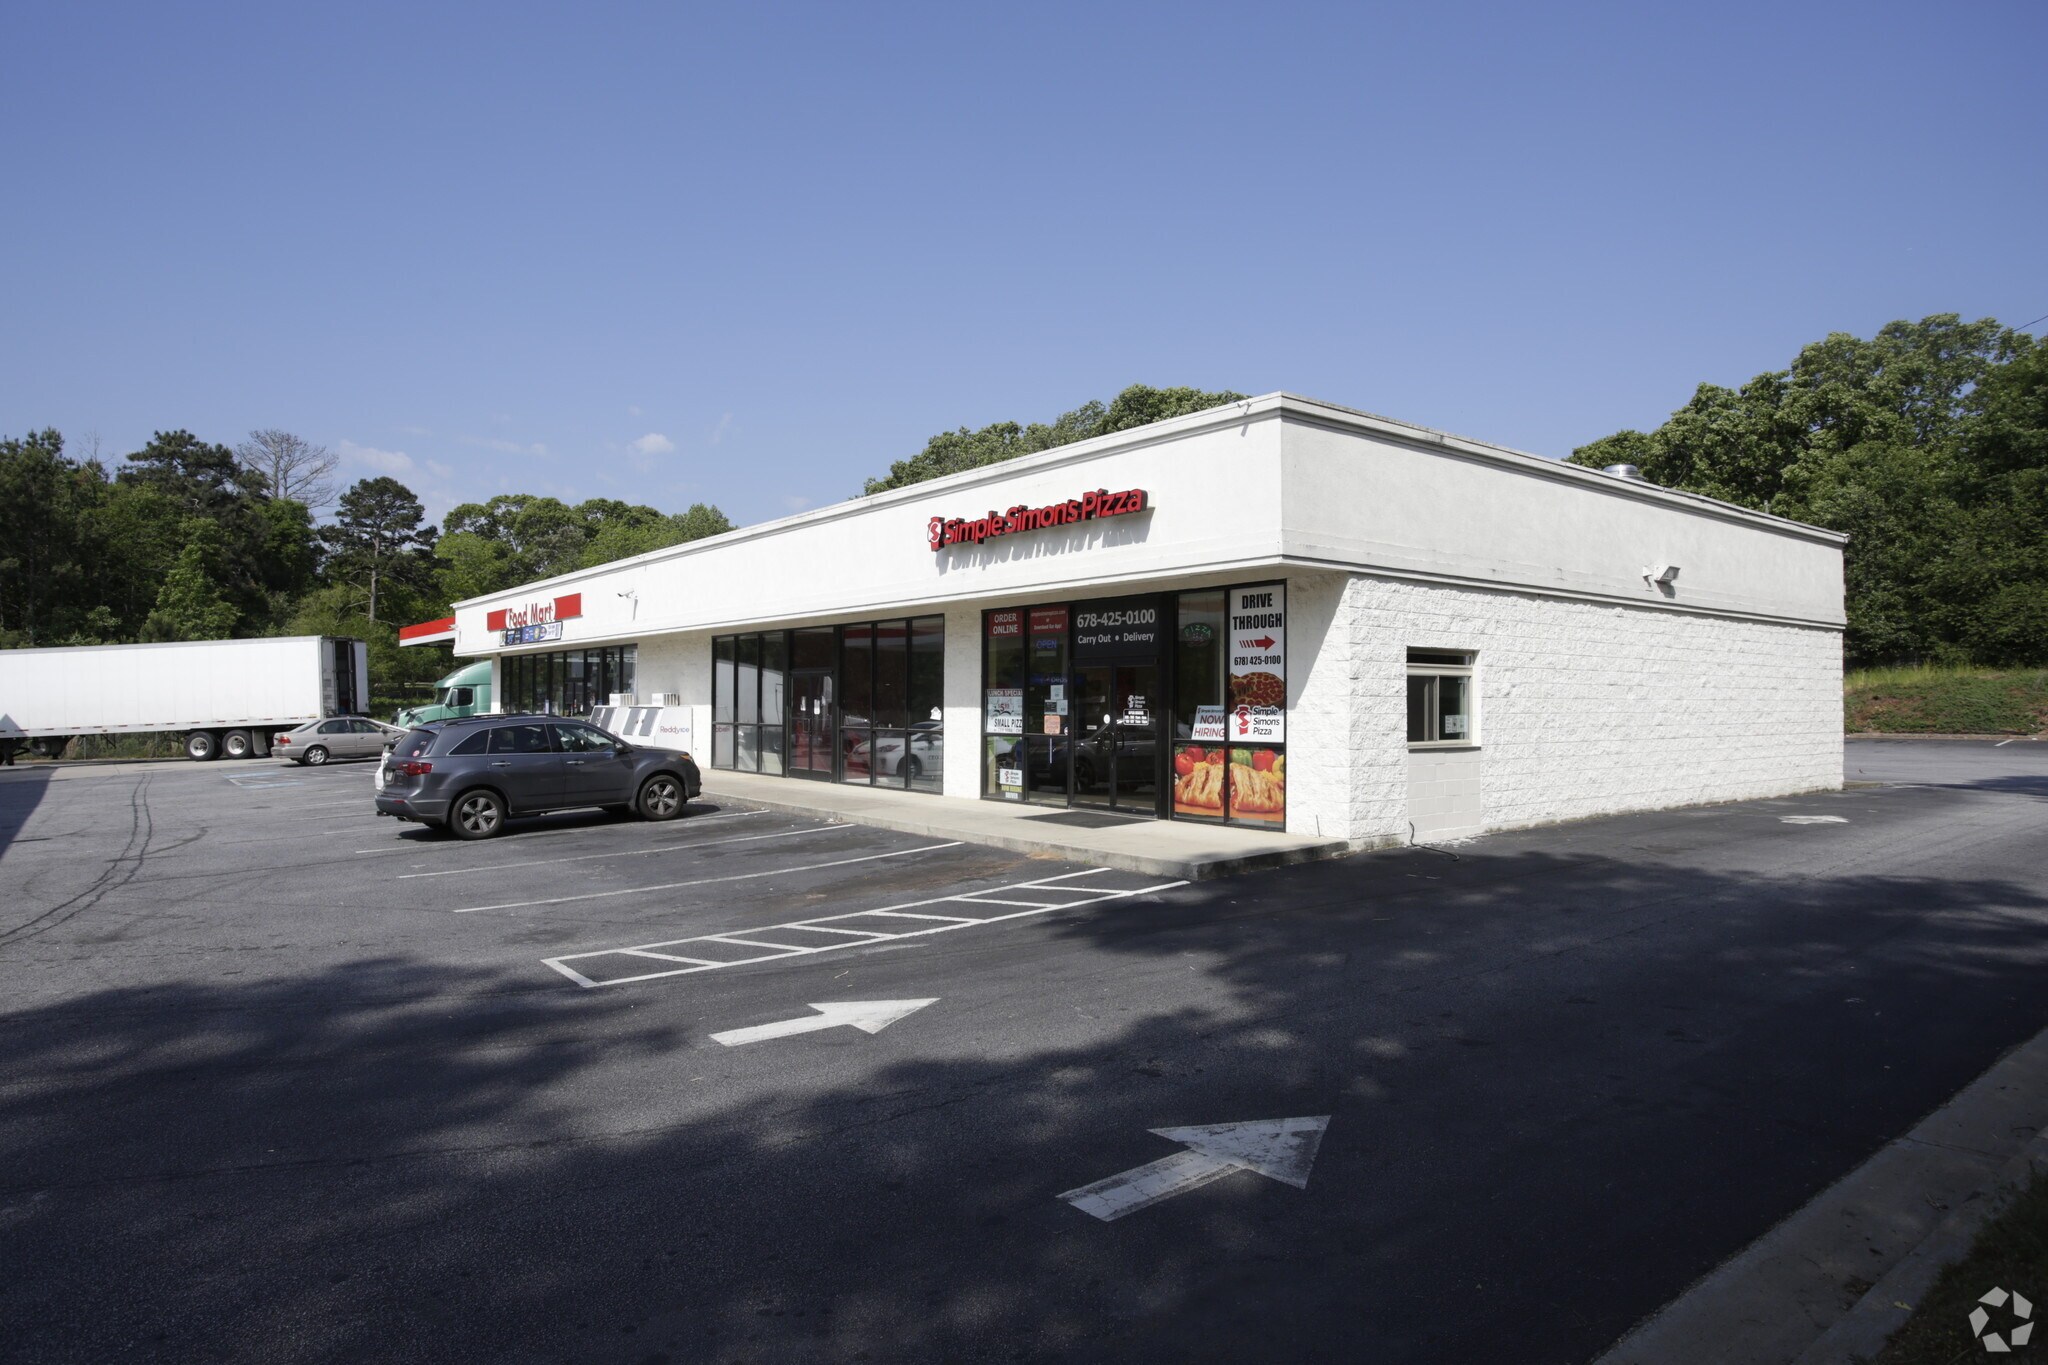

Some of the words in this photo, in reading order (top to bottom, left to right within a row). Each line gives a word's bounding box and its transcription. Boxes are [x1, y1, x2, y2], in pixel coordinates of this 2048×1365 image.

[943, 510, 1003, 544] Simple
[1081, 488, 1147, 521] Pizza
[1241, 592, 1273, 609] DRIVE
[507, 603, 527, 628] Food
[531, 602, 554, 625] Mart
[994, 613, 1017, 623] ORDER
[1077, 609, 1156, 628] 678-425-0100
[1232, 613, 1283, 630] THROUGH
[992, 625, 1018, 634] ONLINE
[1184, 624, 1212, 639] PIZZA
[1077, 635, 1097, 645] Carry
[1098, 634, 1111, 643] Out
[1123, 632, 1154, 643] Delivery
[1036, 640, 1057, 649] OPEN
[1234, 656, 1248, 666] 678)
[1249, 655, 1281, 665] 425-0100
[1252, 706, 1279, 717] Simple
[994, 718, 1011, 728] SMALL
[1012, 719, 1023, 728] PIZZ
[1199, 715, 1225, 725] NOW
[1193, 727, 1225, 738] HIRING
[1252, 727, 1272, 736] Pizza
